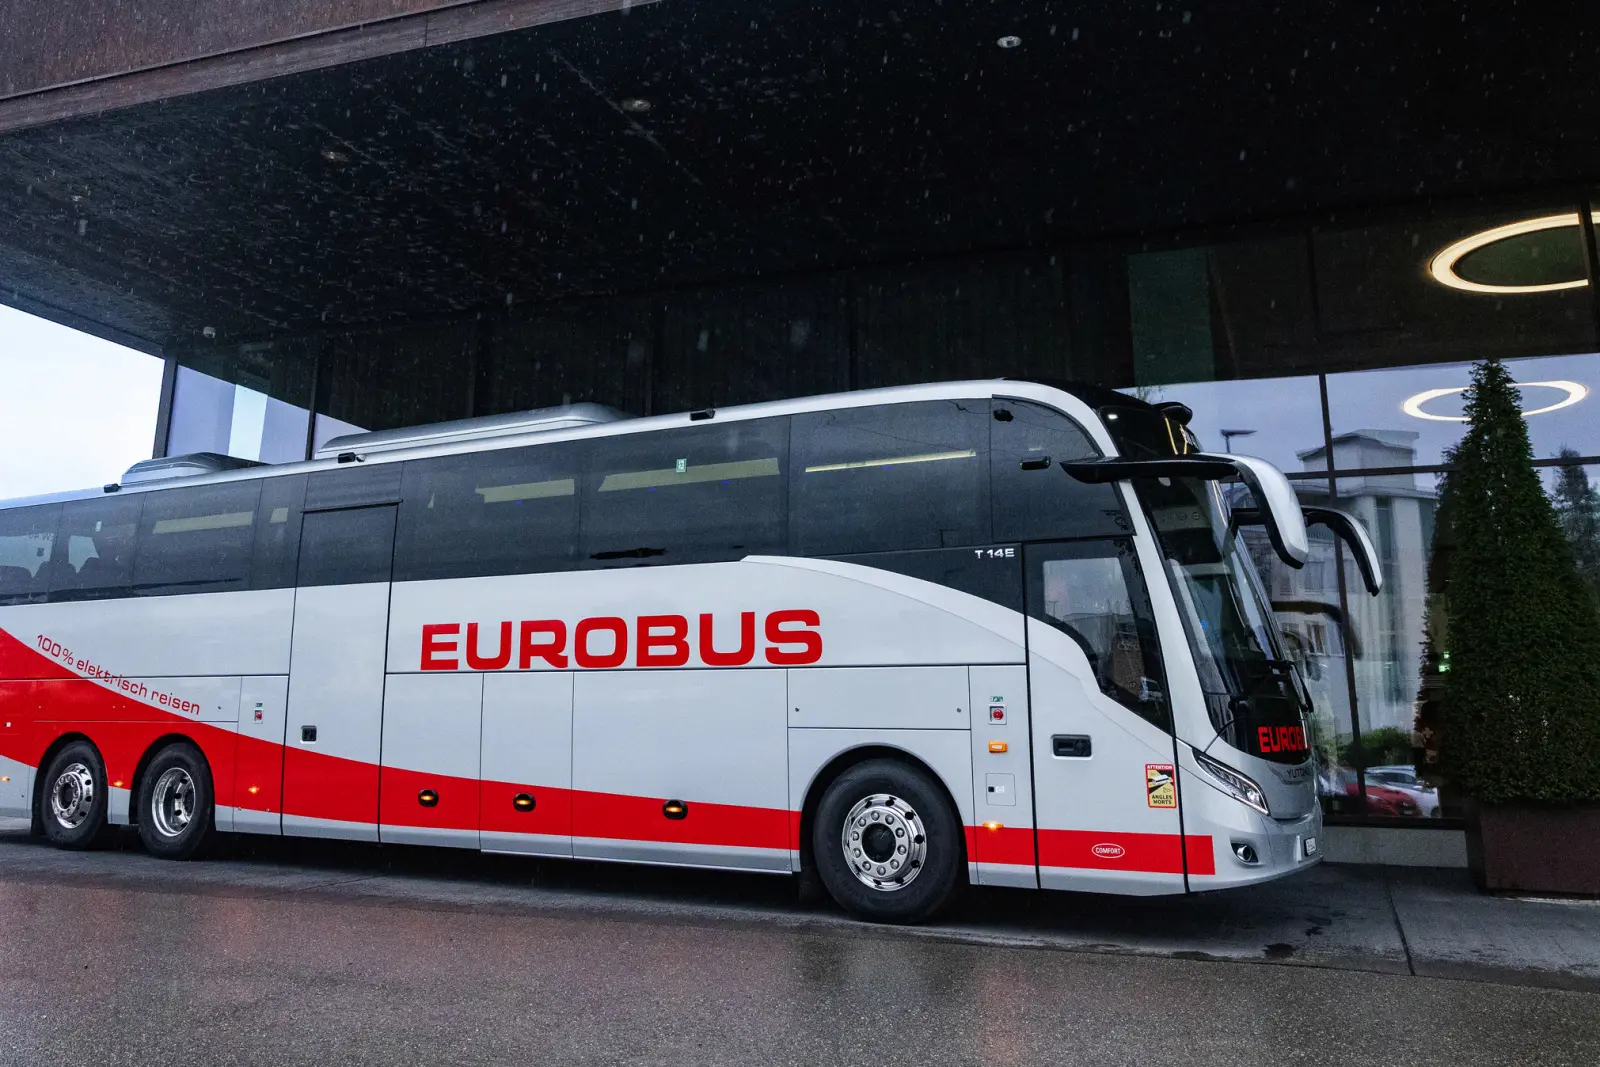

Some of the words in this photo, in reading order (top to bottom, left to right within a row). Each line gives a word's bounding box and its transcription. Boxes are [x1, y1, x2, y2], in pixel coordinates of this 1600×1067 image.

[974, 550, 984, 558] T
[986, 548, 1014, 558] 14E
[420, 609, 823, 671] EUROBUS
[37, 634, 74, 666] 100%
[76, 659, 148, 698] elektrisch
[150, 690, 200, 715] reisen
[1257, 726, 1307, 752] EUROB
